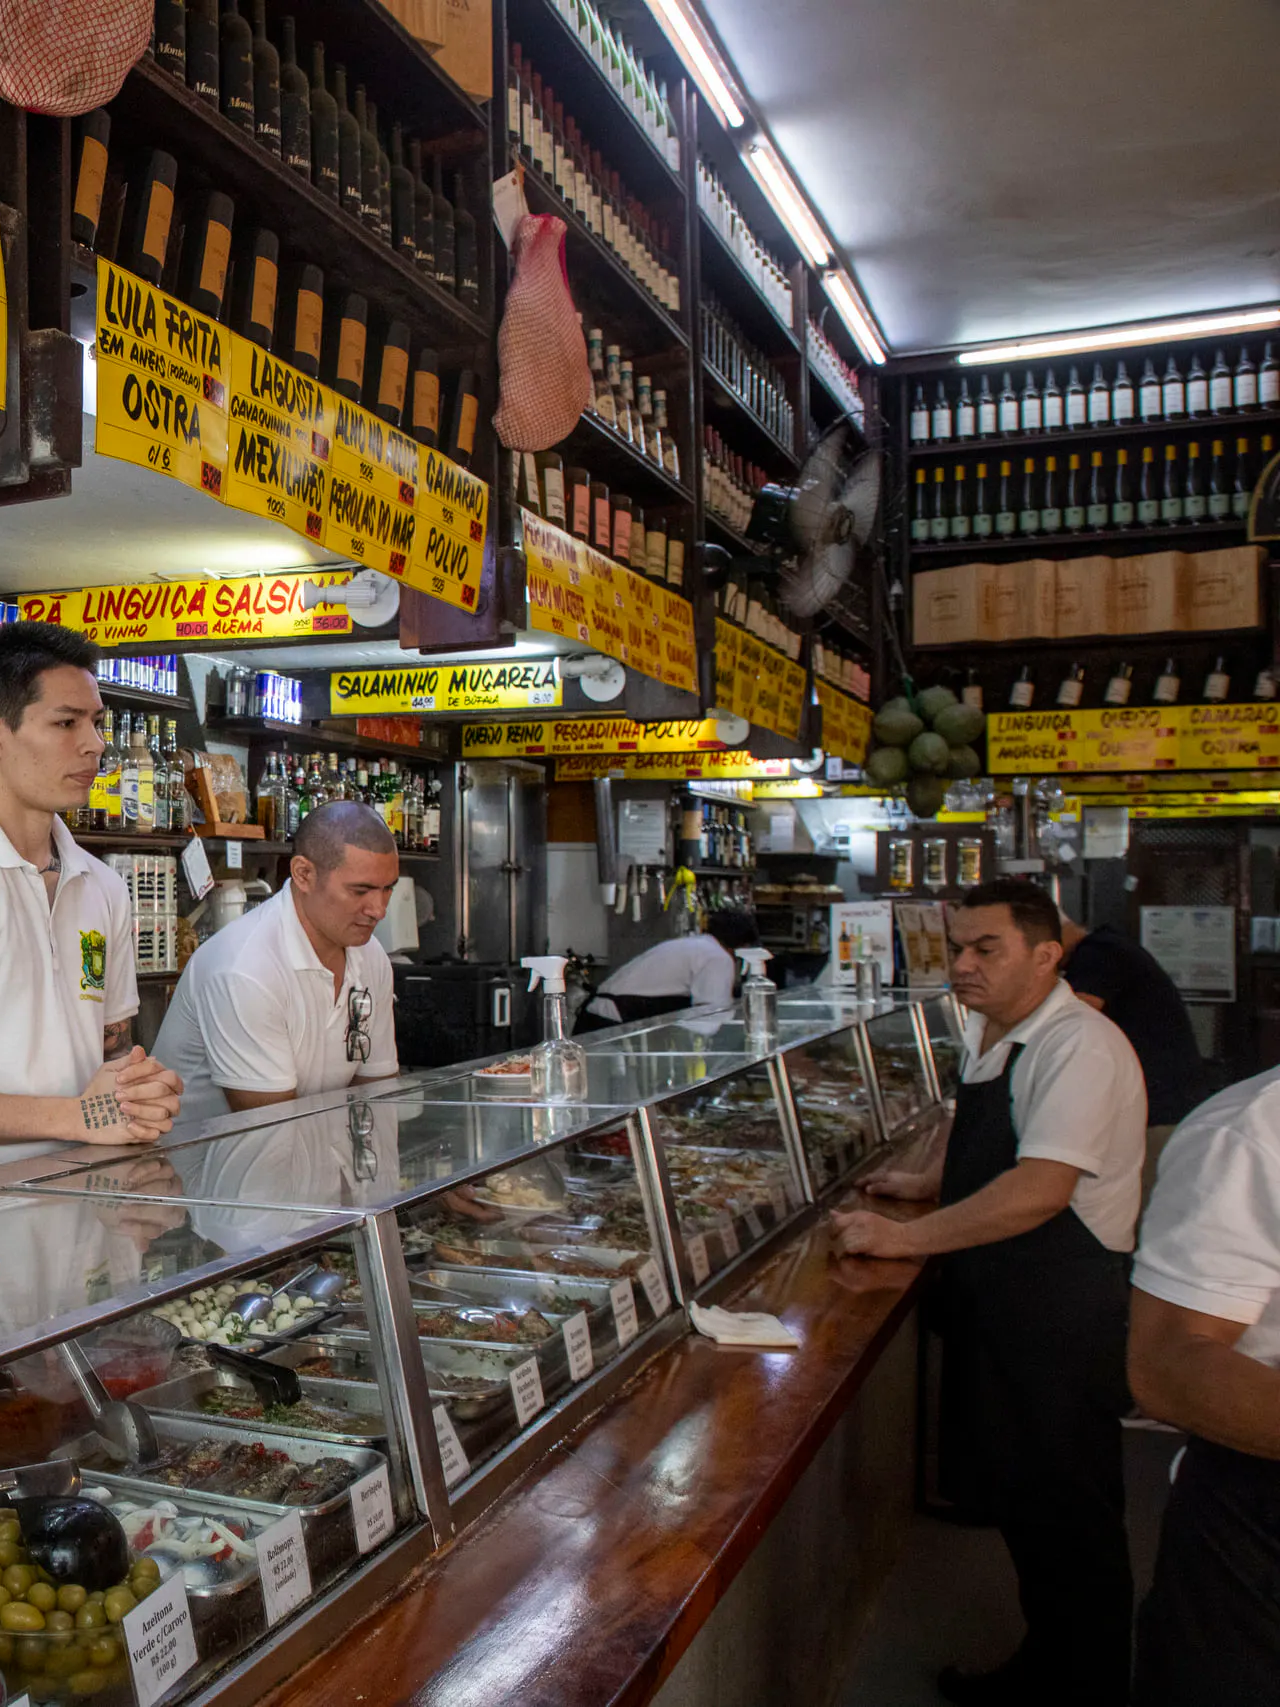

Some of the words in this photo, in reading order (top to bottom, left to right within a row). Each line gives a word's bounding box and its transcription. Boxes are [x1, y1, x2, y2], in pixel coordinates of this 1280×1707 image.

[99, 327, 124, 359] EM
[105, 267, 157, 342] LULA
[162, 298, 221, 374] FRITA
[250, 347, 324, 425] LAGOSTA
[123, 374, 201, 450] OSTRA
[231, 396, 292, 440] CAVAQUINHA
[336, 400, 365, 454] ALHO
[369, 421, 382, 462] NO
[377, 500, 390, 545] DO
[390, 510, 415, 553] MAR
[425, 527, 468, 581] POLVO
[105, 624, 148, 640] VINHO
[212, 618, 264, 634] ALEMÃ
[336, 670, 439, 698] SALAMINHO
[448, 666, 557, 694] MUÇARELA
[464, 724, 502, 747] QUEIJO
[506, 724, 544, 744] REINO
[553, 720, 638, 742] PESCADINHA
[642, 720, 700, 740] POLVO
[132, 1640, 155, 1665] Verde
[155, 1610, 188, 1651] c/Caroço
[141, 1601, 174, 1635] Azeitona
